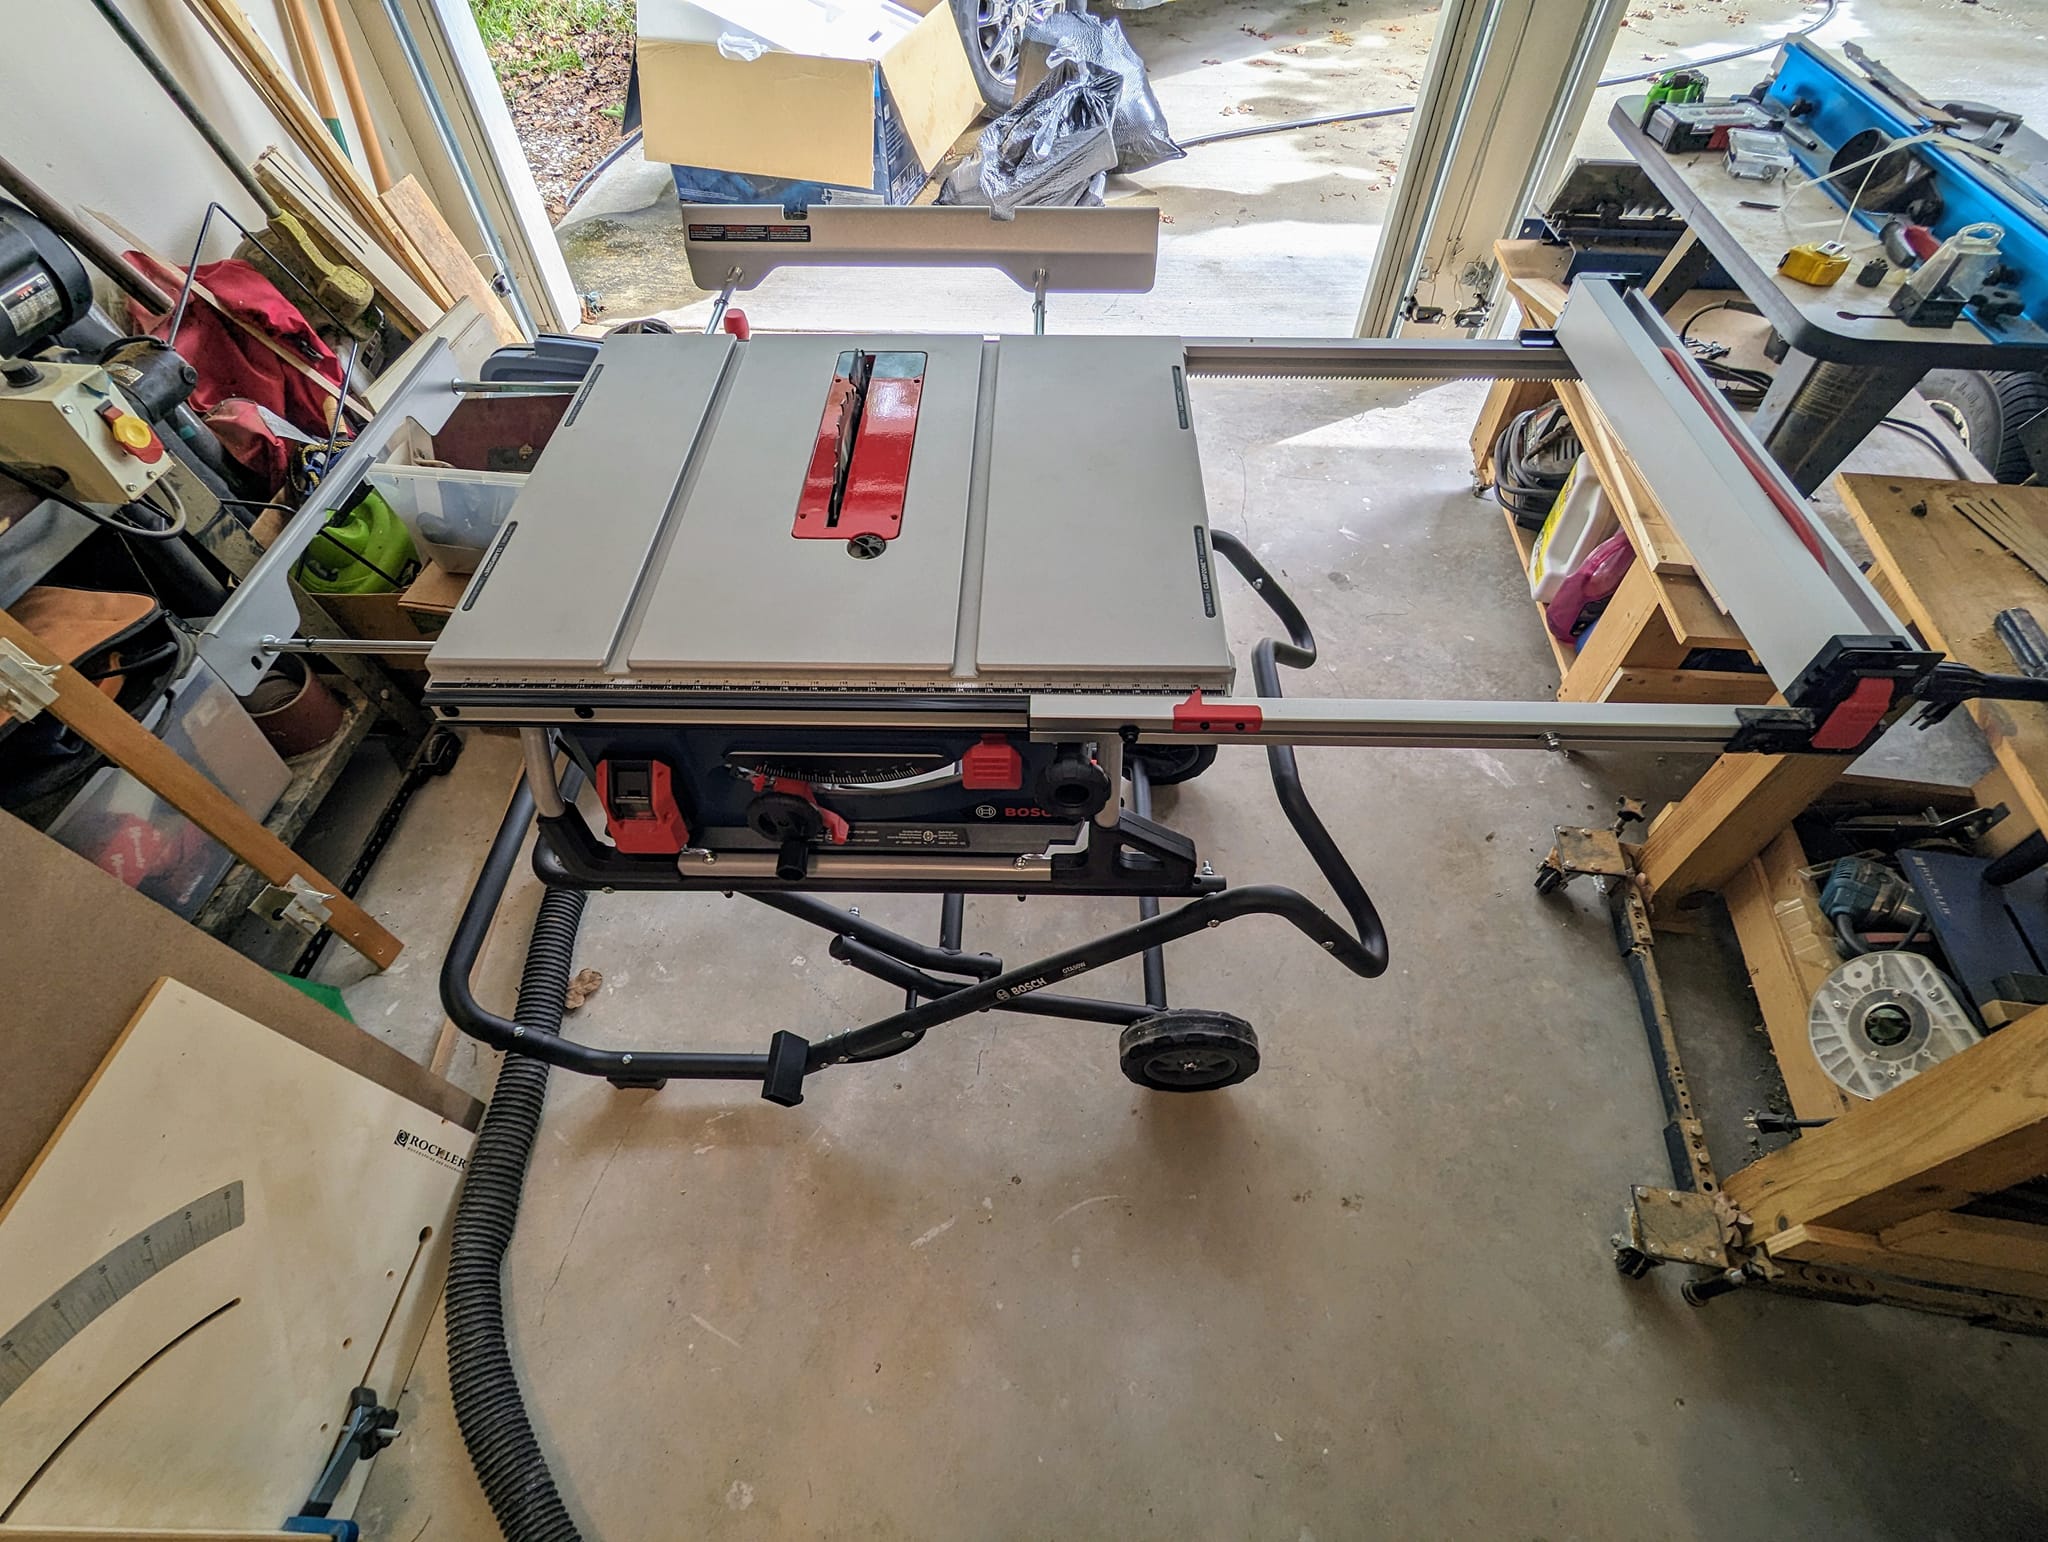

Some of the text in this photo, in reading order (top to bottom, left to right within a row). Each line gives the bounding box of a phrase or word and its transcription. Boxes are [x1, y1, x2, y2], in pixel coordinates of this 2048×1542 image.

[1004, 807, 1052, 817] BOS
[1010, 977, 1047, 996] BOSCH
[409, 1135, 467, 1168] ROCKLER
